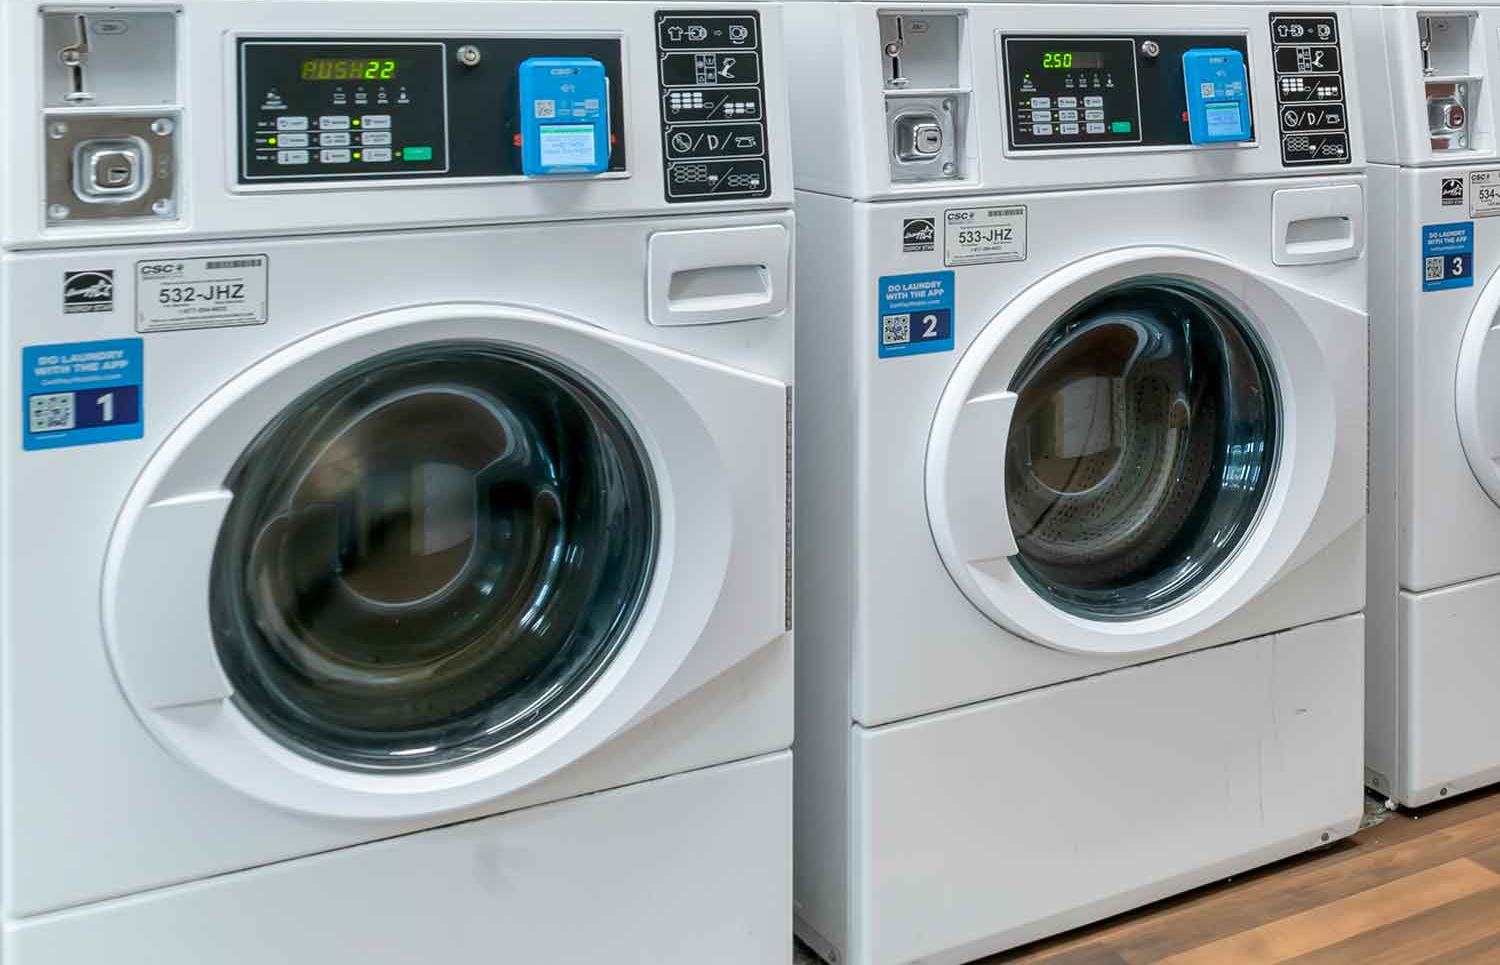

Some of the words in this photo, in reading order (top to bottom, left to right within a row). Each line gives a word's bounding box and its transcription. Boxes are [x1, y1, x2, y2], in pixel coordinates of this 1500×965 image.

[947, 212, 968, 220] CSC
[959, 229, 1012, 243] 533-JHZ
[141, 265, 174, 274] CSC
[1452, 257, 1463, 275] 3
[159, 284, 244, 303] 532-JHZ
[922, 314, 937, 337] 2
[97, 393, 114, 421] 1
